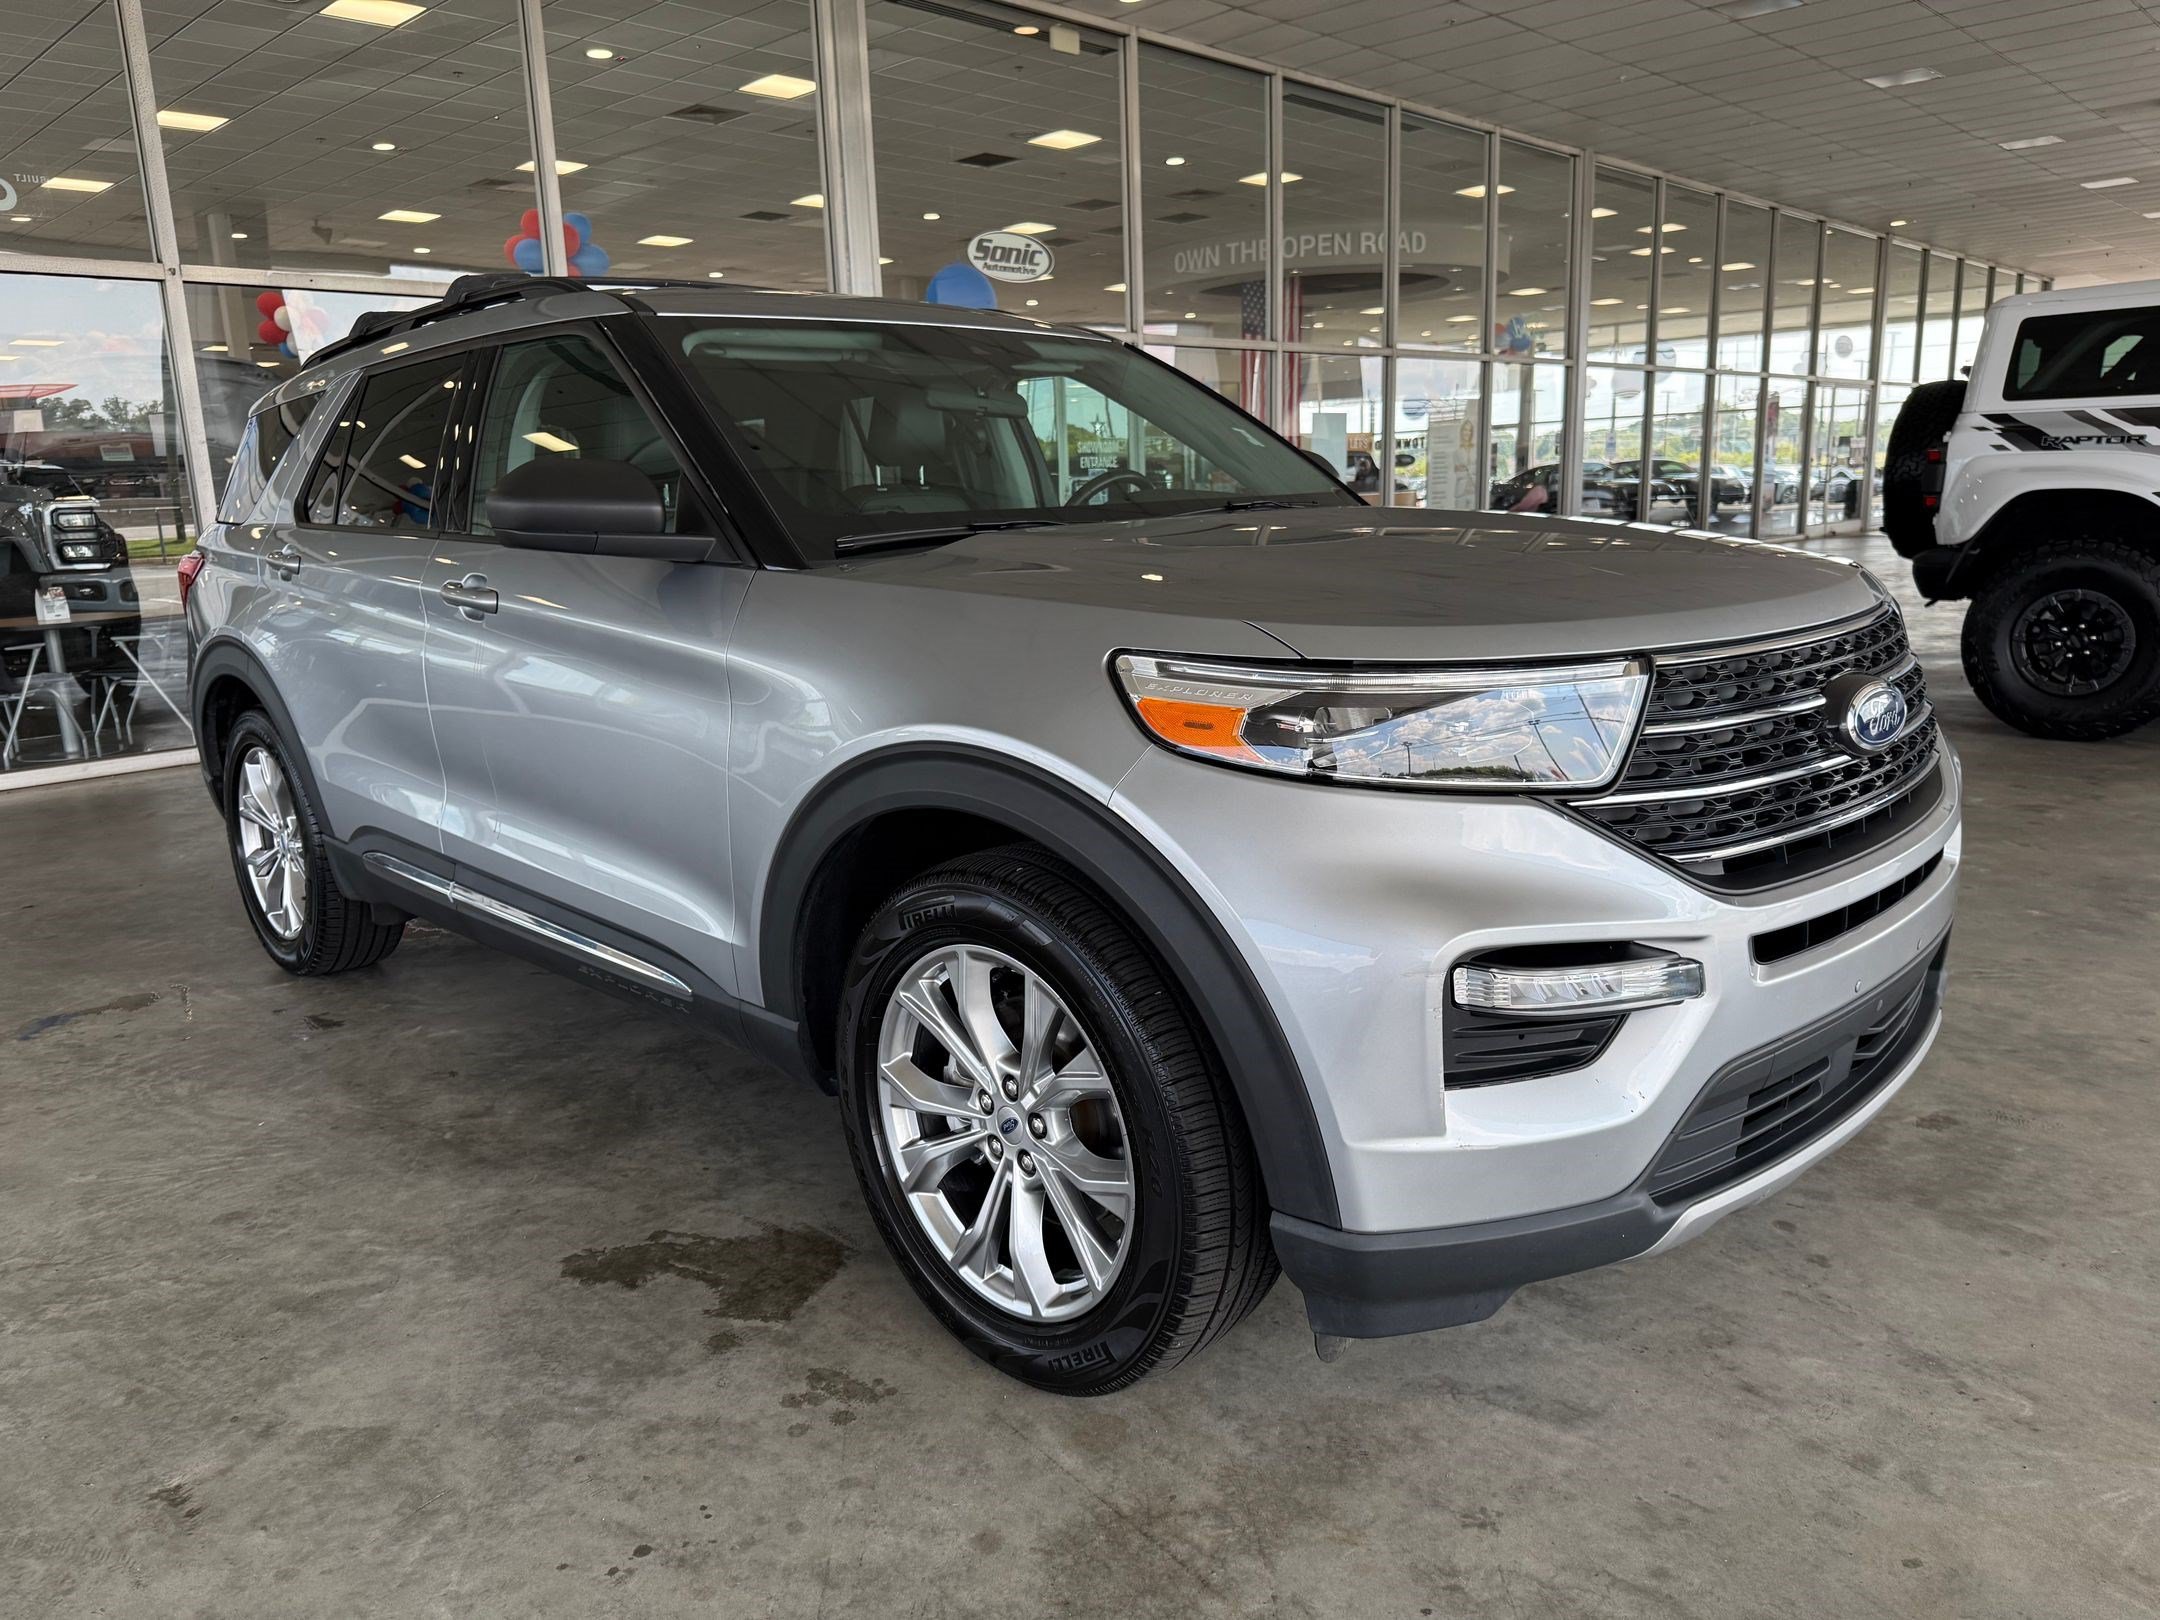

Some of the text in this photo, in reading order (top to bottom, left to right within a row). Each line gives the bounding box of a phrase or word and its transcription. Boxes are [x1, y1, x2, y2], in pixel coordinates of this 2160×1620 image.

[973, 238, 1043, 267] Sonic
[1174, 245, 1220, 273] OWN
[1282, 232, 1350, 258] OPEN
[982, 261, 1037, 276] Automotive
[2040, 434, 2147, 451] RAPTOR
[1079, 456, 1120, 469] ENTRANCE
[1145, 682, 1254, 701] EXPLORER
[899, 896, 957, 931] PIRELLI
[1047, 1341, 1119, 1376] PIRELLI
